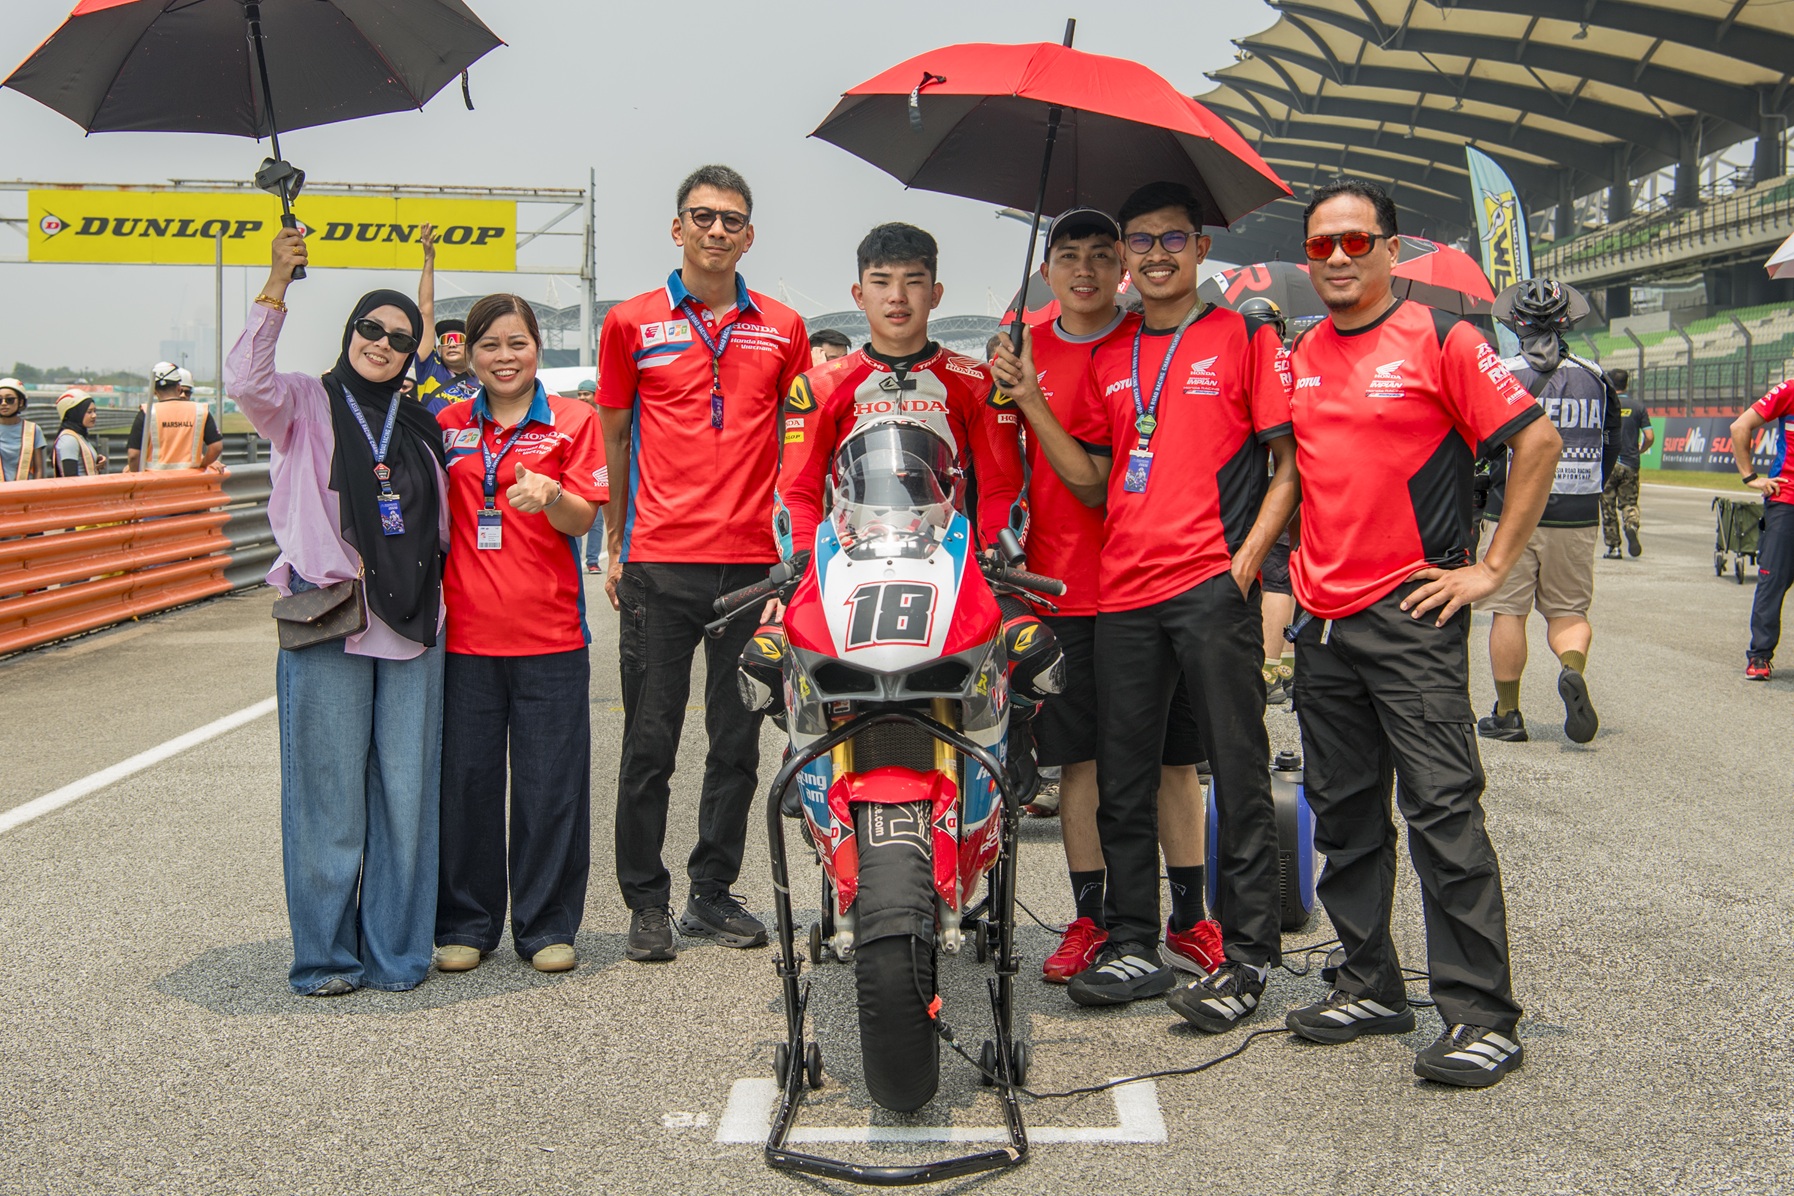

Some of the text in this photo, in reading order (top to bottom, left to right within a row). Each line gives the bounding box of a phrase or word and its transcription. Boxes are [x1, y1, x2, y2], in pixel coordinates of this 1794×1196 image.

[75, 216, 264, 239] DUNLOP
[733, 323, 779, 334] HONDA
[946, 364, 984, 379] HONDA
[1105, 378, 1133, 396] MOTU
[855, 400, 949, 416] HONDA
[845, 580, 938, 652] 18
